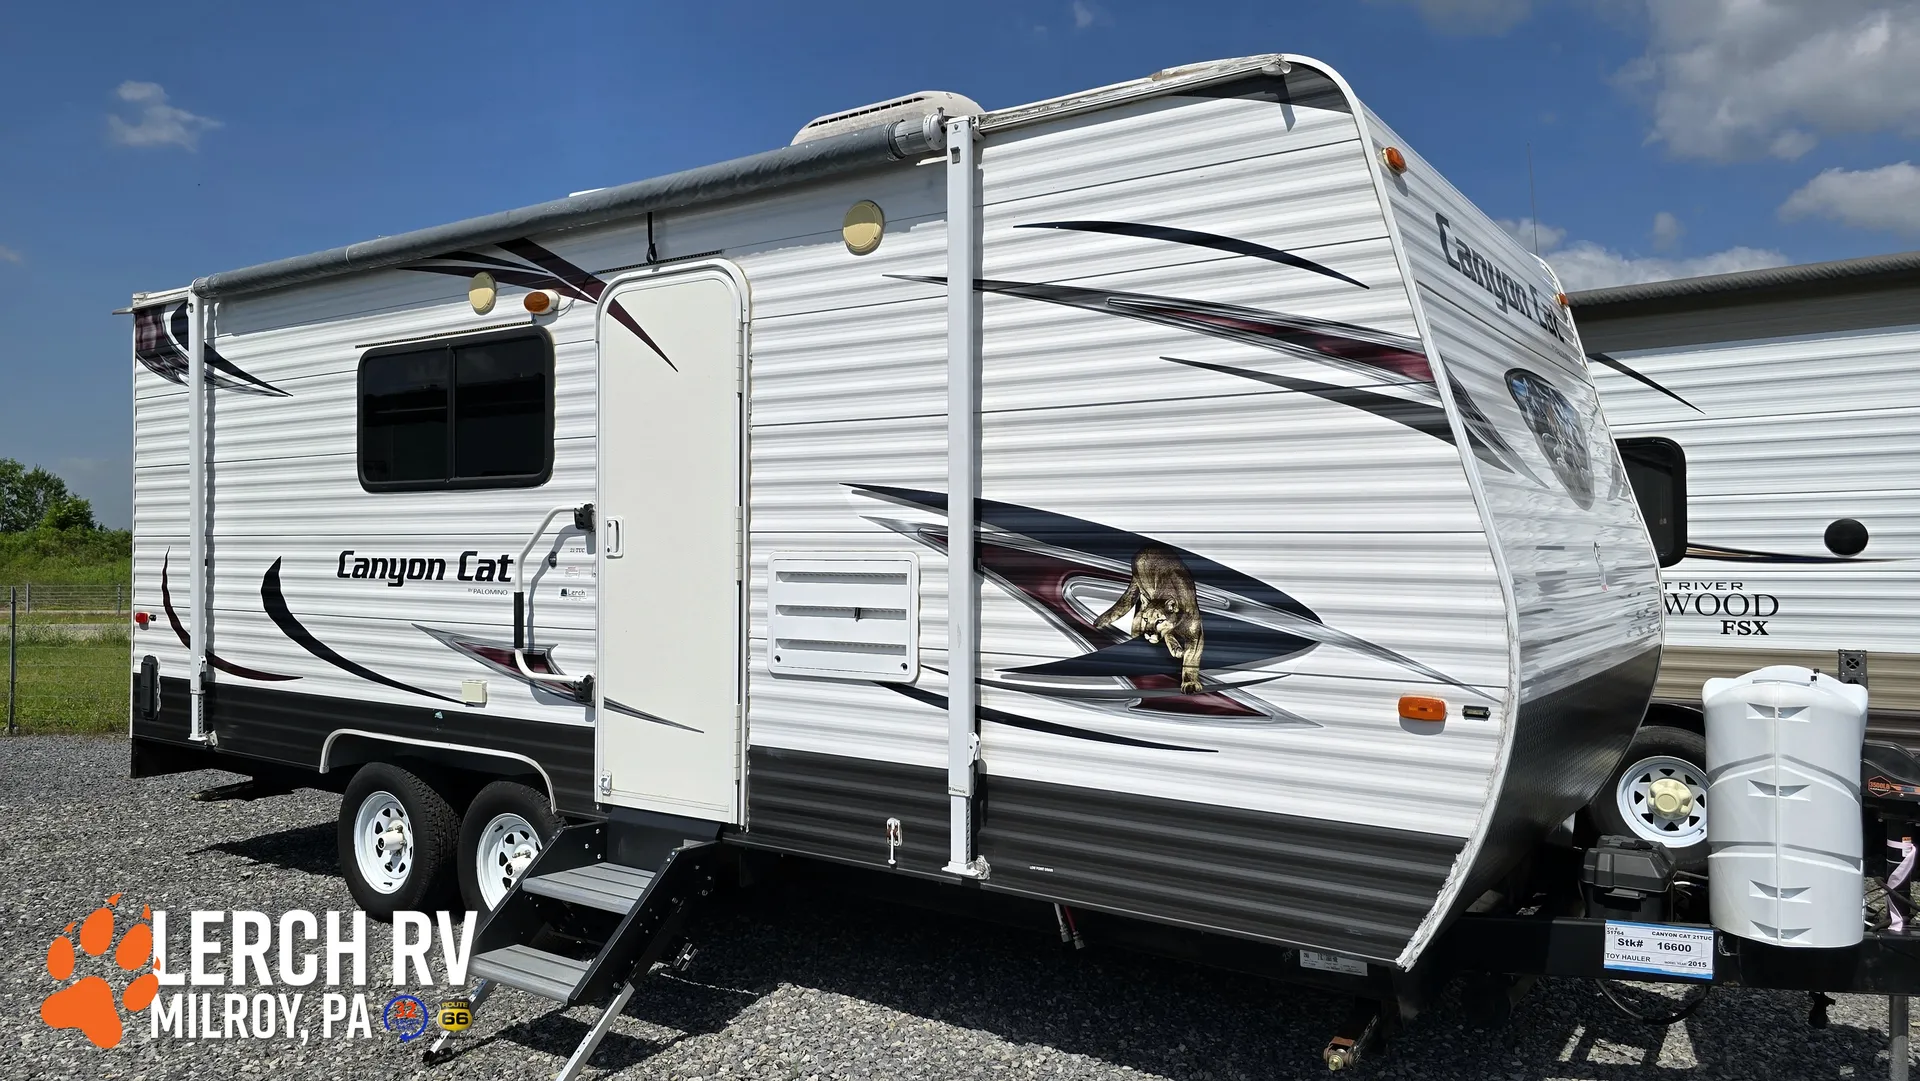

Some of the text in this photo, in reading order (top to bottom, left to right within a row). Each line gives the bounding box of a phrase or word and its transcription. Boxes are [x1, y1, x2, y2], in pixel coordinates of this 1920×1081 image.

[1435, 212, 1565, 343] Canyon Cat
[337, 550, 514, 588] Canyon Cat
[473, 588, 508, 596] PALOMINO
[1679, 582, 1743, 590] RIVER
[1720, 620, 1769, 636] FSX
[1617, 938, 1692, 952] Stk# 16600
[1621, 954, 1651, 962] HAULER
